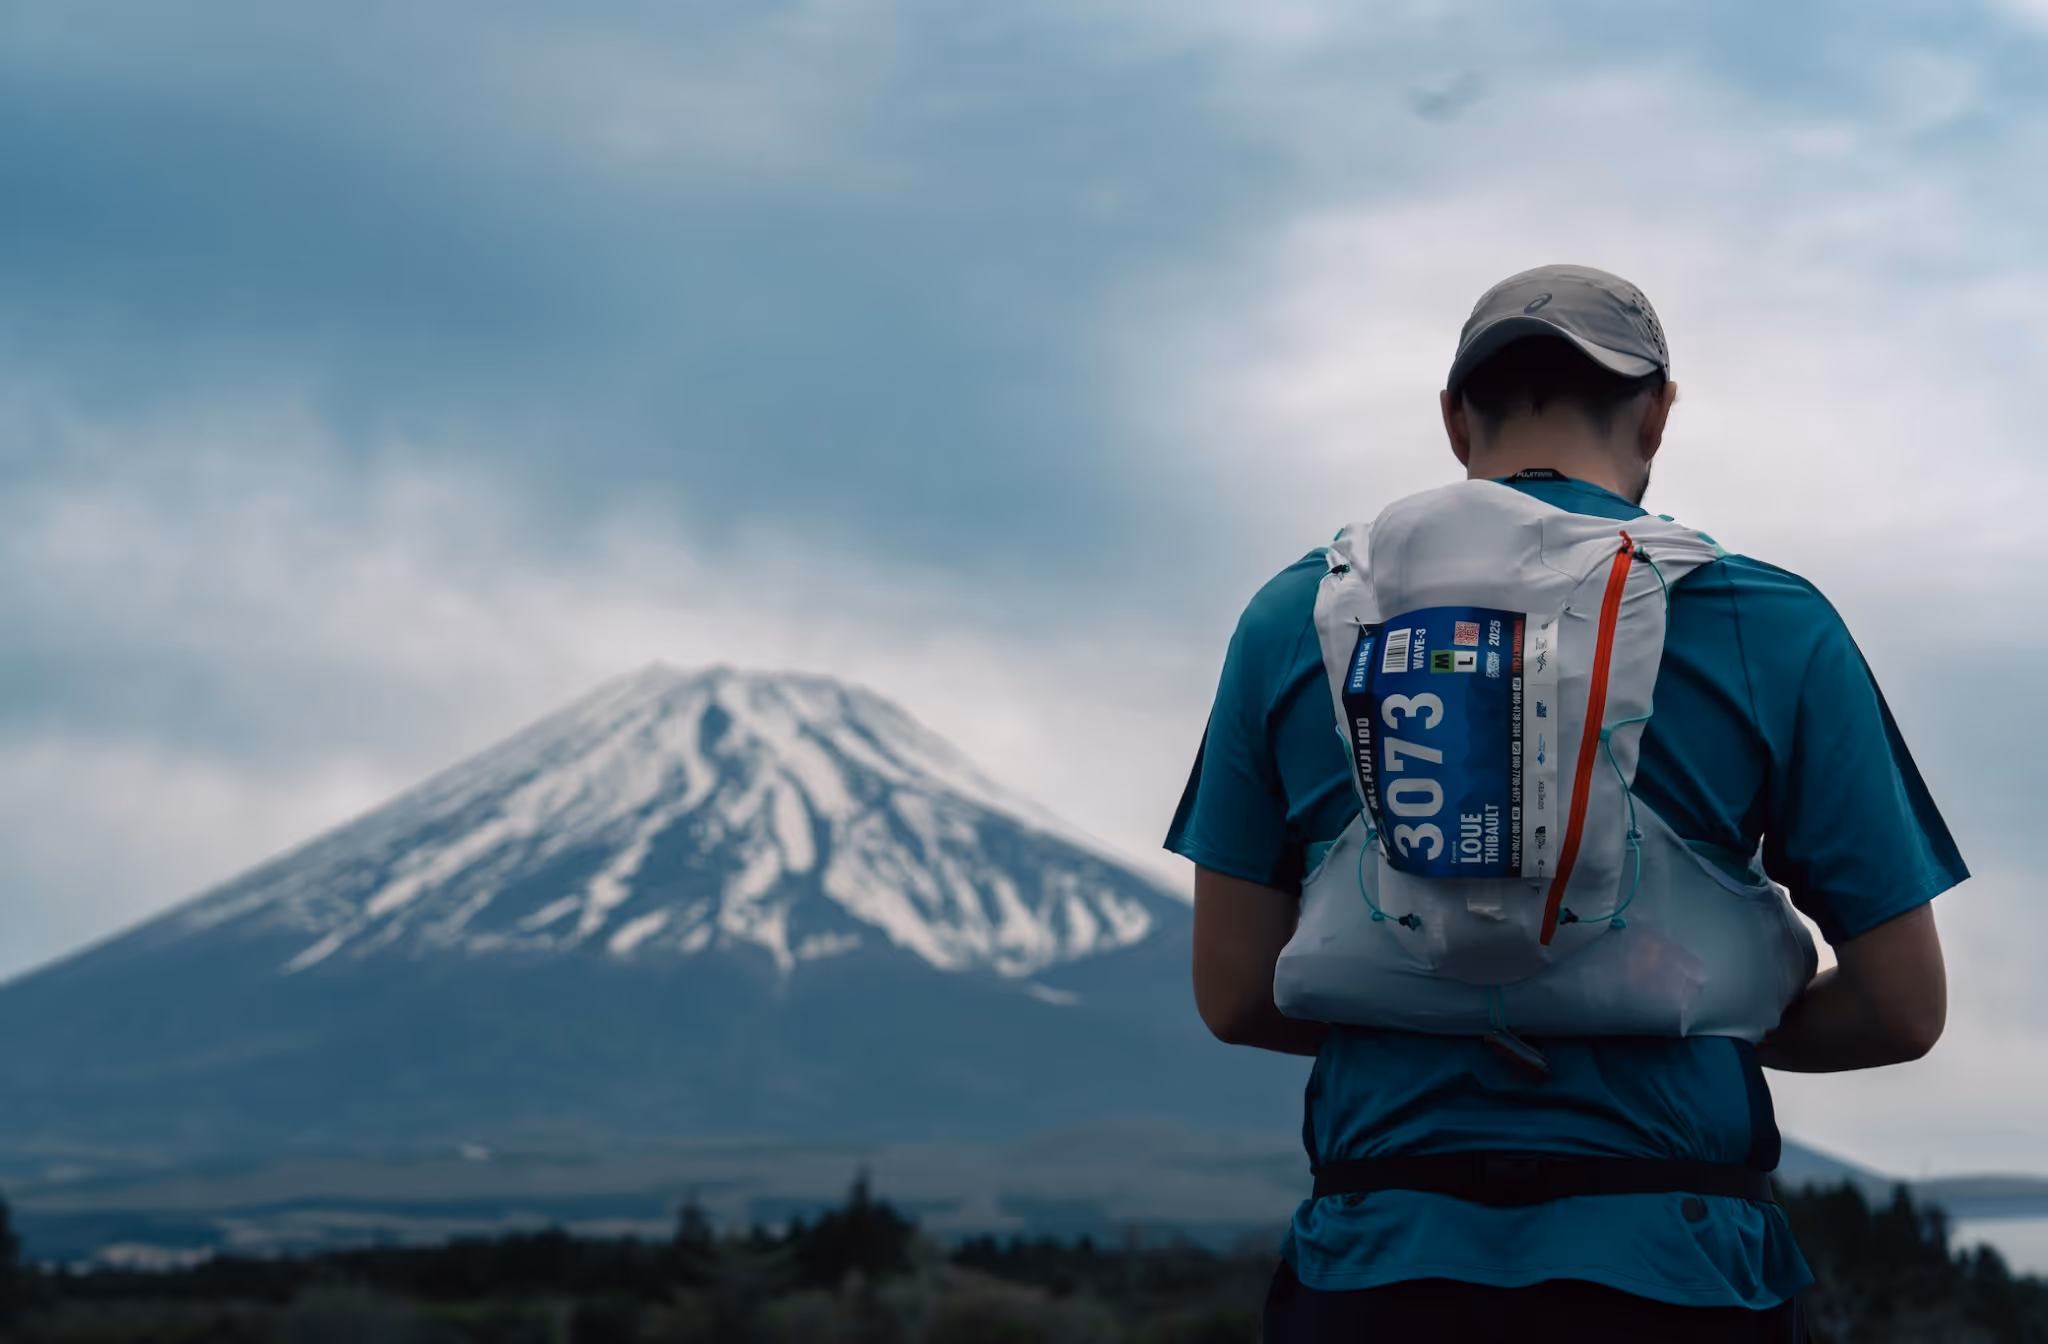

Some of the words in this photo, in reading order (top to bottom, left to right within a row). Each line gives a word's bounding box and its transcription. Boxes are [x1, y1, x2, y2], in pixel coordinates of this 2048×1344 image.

[1413, 628, 1426, 670] WAVE-3
[1488, 620, 1501, 647] 2025
[1434, 653, 1449, 669] M
[1458, 656, 1473, 665] L
[1356, 717, 1370, 744] 100
[1381, 692, 1444, 860] 3073
[1460, 813, 1482, 863] LOUE
[1485, 804, 1499, 864] THIBAULT
